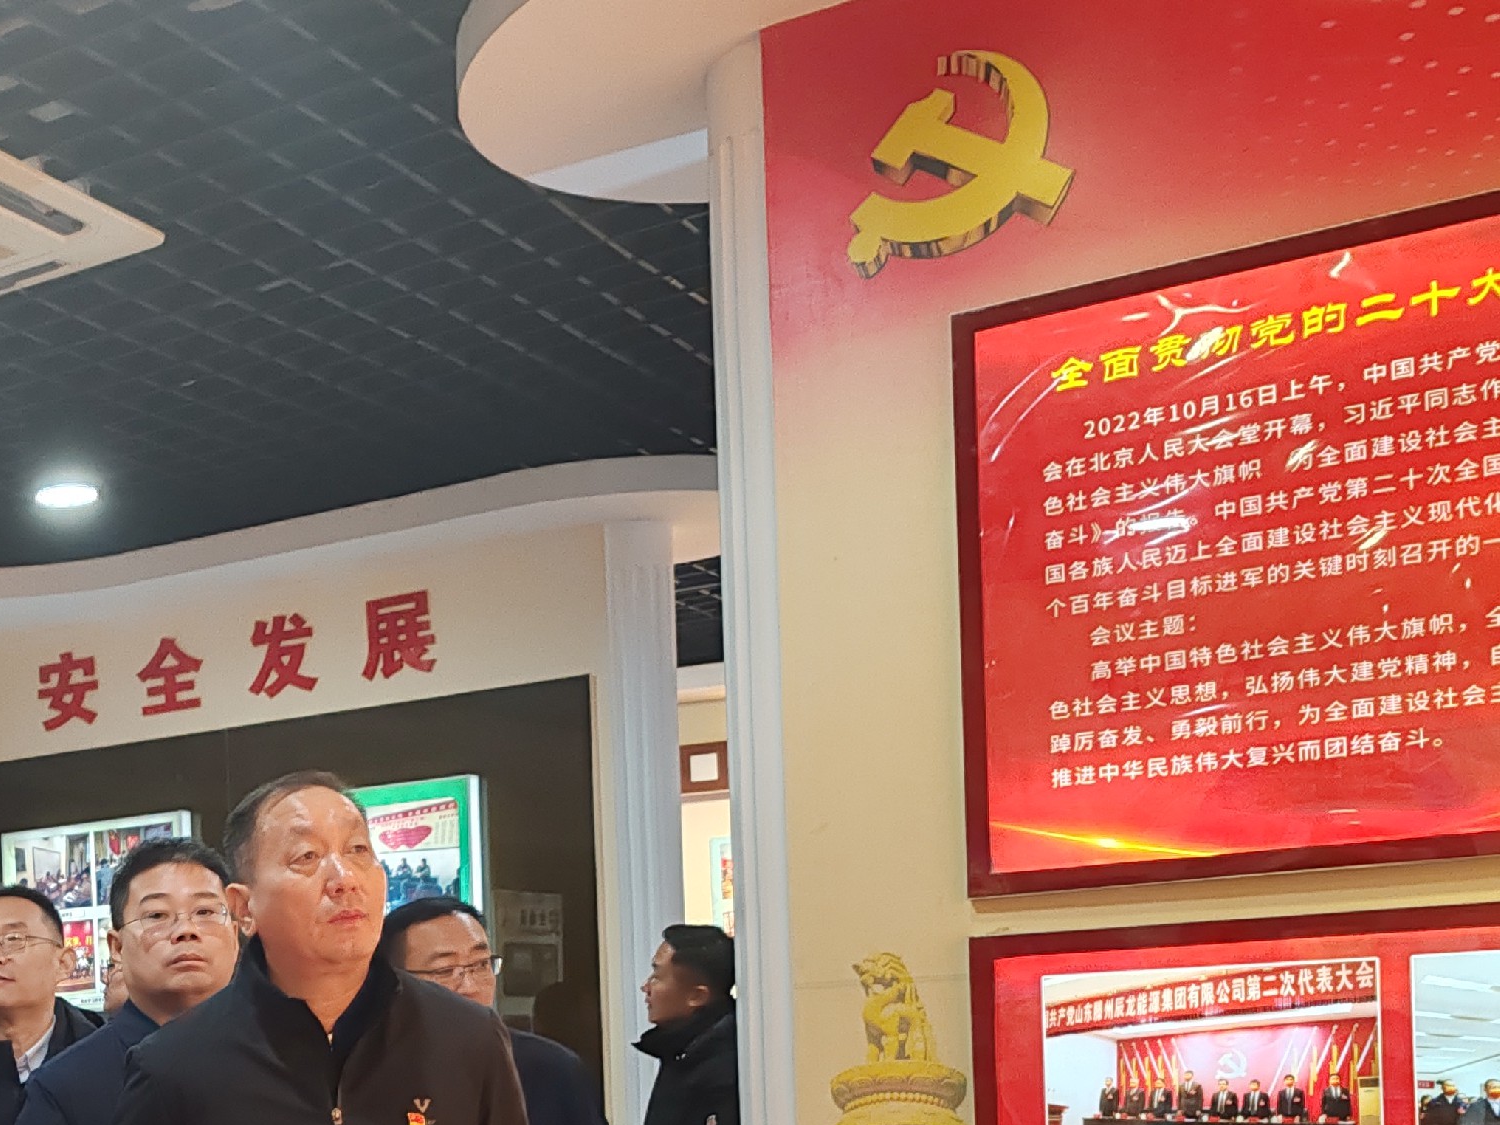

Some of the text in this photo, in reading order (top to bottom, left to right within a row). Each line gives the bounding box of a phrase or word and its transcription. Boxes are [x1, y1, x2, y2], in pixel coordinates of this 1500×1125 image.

[37, 589, 437, 731] 安全发展
[1090, 614, 1196, 646] 会议主题：
[1051, 728, 1443, 789] 推进中华民族伟大复兴而团结奋斗。
